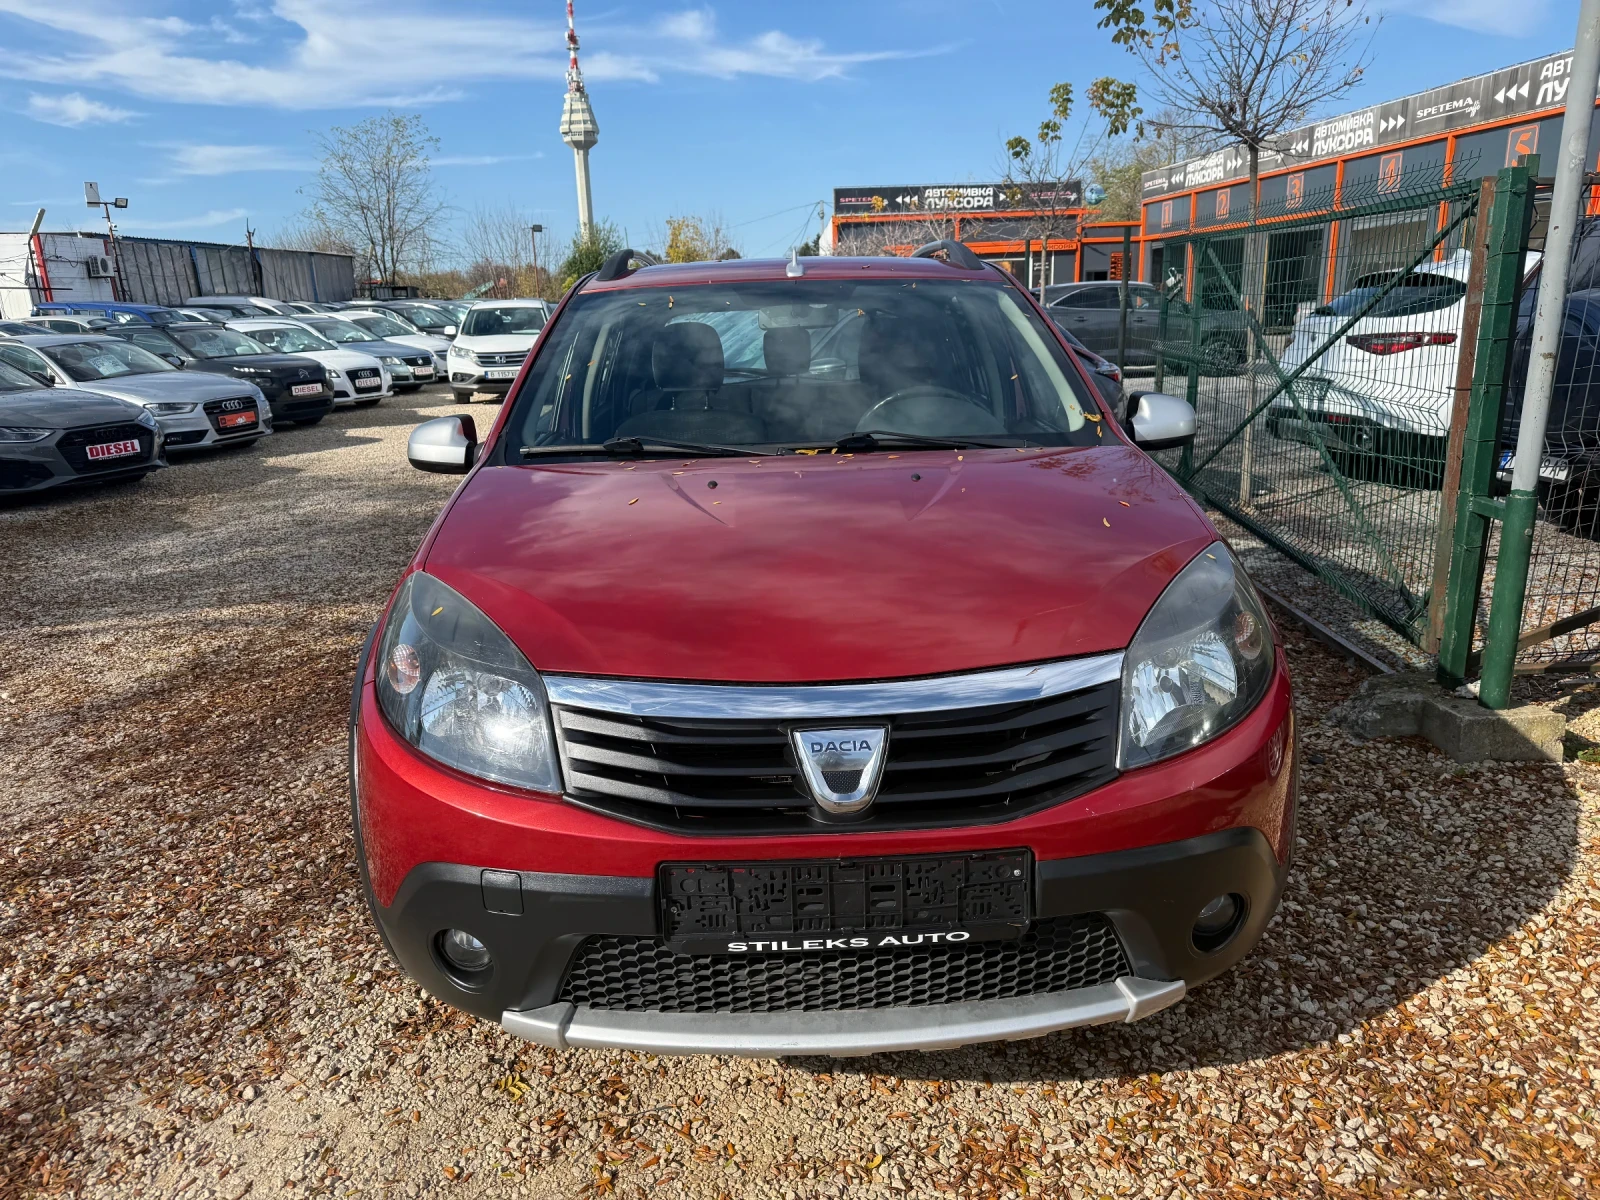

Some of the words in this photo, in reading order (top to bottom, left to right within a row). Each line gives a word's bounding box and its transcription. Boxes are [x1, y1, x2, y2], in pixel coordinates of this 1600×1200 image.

[1540, 57, 1574, 80] АВТ
[1536, 77, 1570, 105] ЛУ
[1416, 97, 1473, 118] SPETEMA
[1314, 112, 1374, 139] АВТОМИВКА
[1312, 128, 1374, 157] ЛУКСОРА
[1185, 167, 1224, 187] ЛУКСОРА
[1385, 158, 1396, 187] 4
[924, 187, 994, 197] АВТОМИВКА
[1291, 178, 1301, 201] 3
[924, 197, 994, 209] ЛУКСОРА
[1218, 193, 1228, 215] 2
[1164, 206, 1170, 225] 1
[294, 385, 320, 394] DIESEL
[357, 378, 379, 386] DIESEL
[89, 441, 138, 458] DIESEL
[811, 740, 872, 753] DACIA
[727, 937, 869, 952] STILEKS
[878, 931, 970, 947] AUTO
